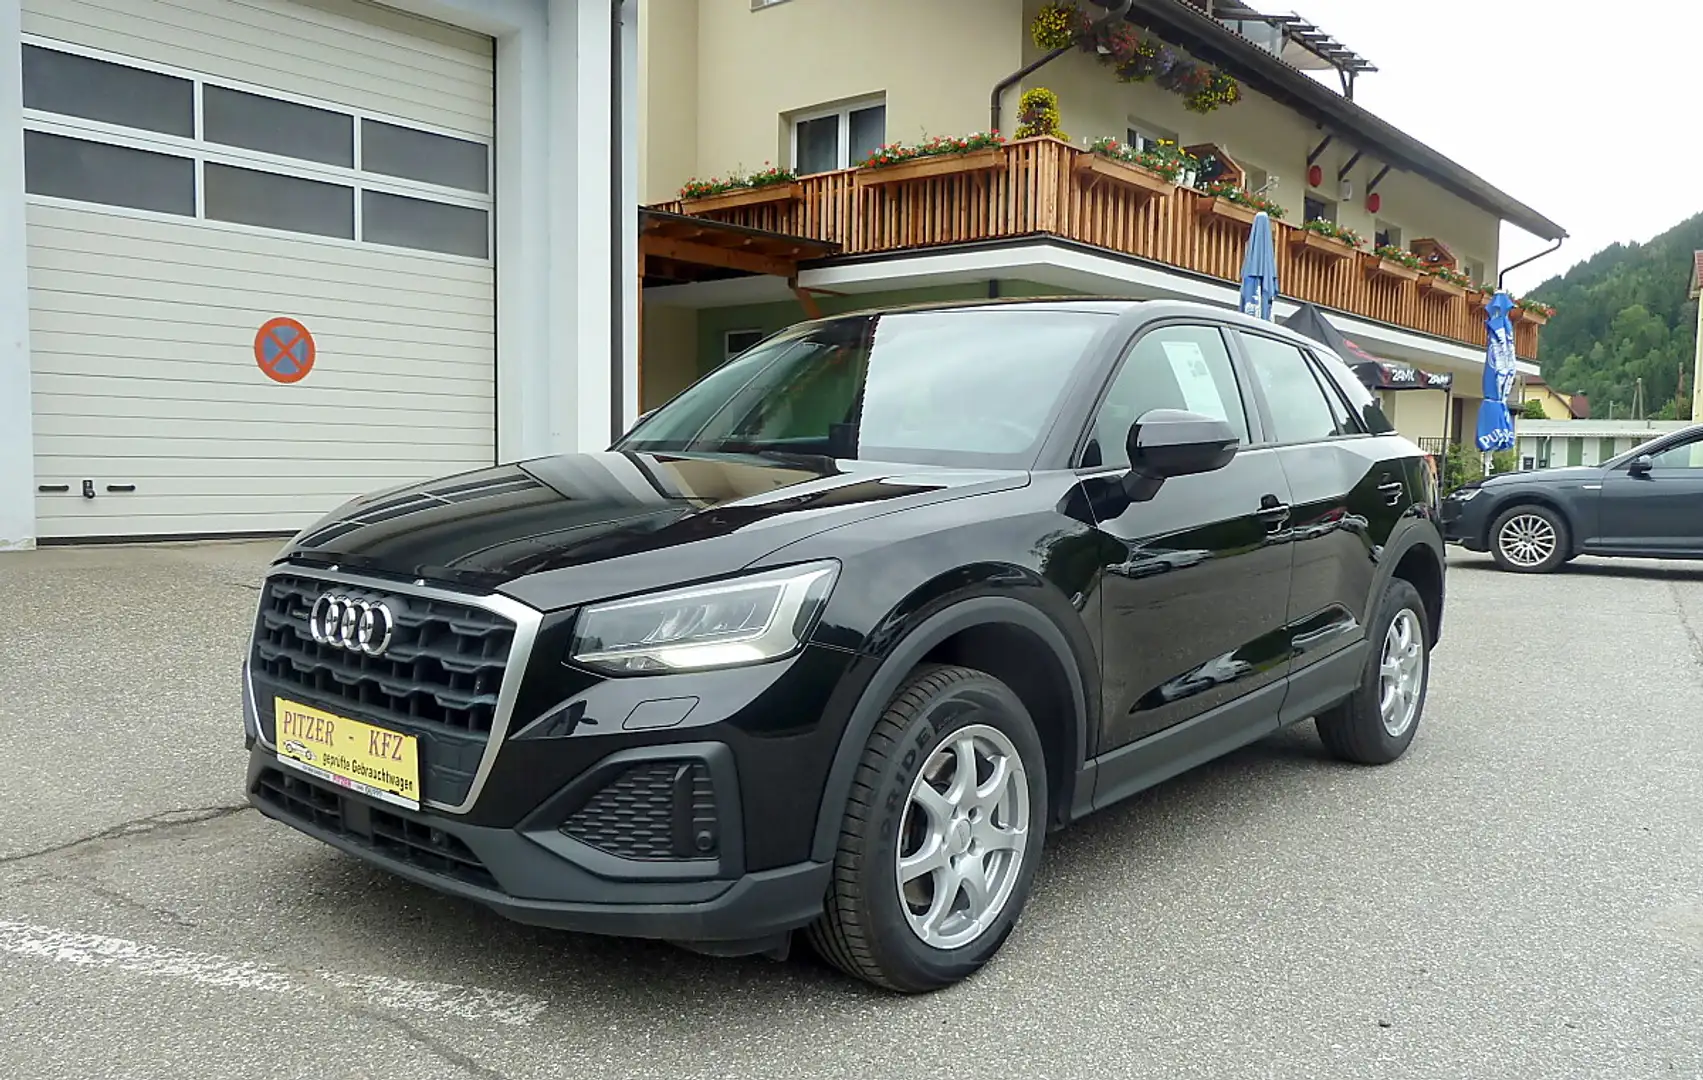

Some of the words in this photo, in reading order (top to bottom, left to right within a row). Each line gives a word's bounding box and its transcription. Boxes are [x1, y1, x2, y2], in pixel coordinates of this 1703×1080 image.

[283, 711, 335, 747] PITZER
[368, 729, 404, 761] KFZ
[322, 752, 351, 771] geprüfte
[351, 759, 413, 792] Gebrauchtwagen
